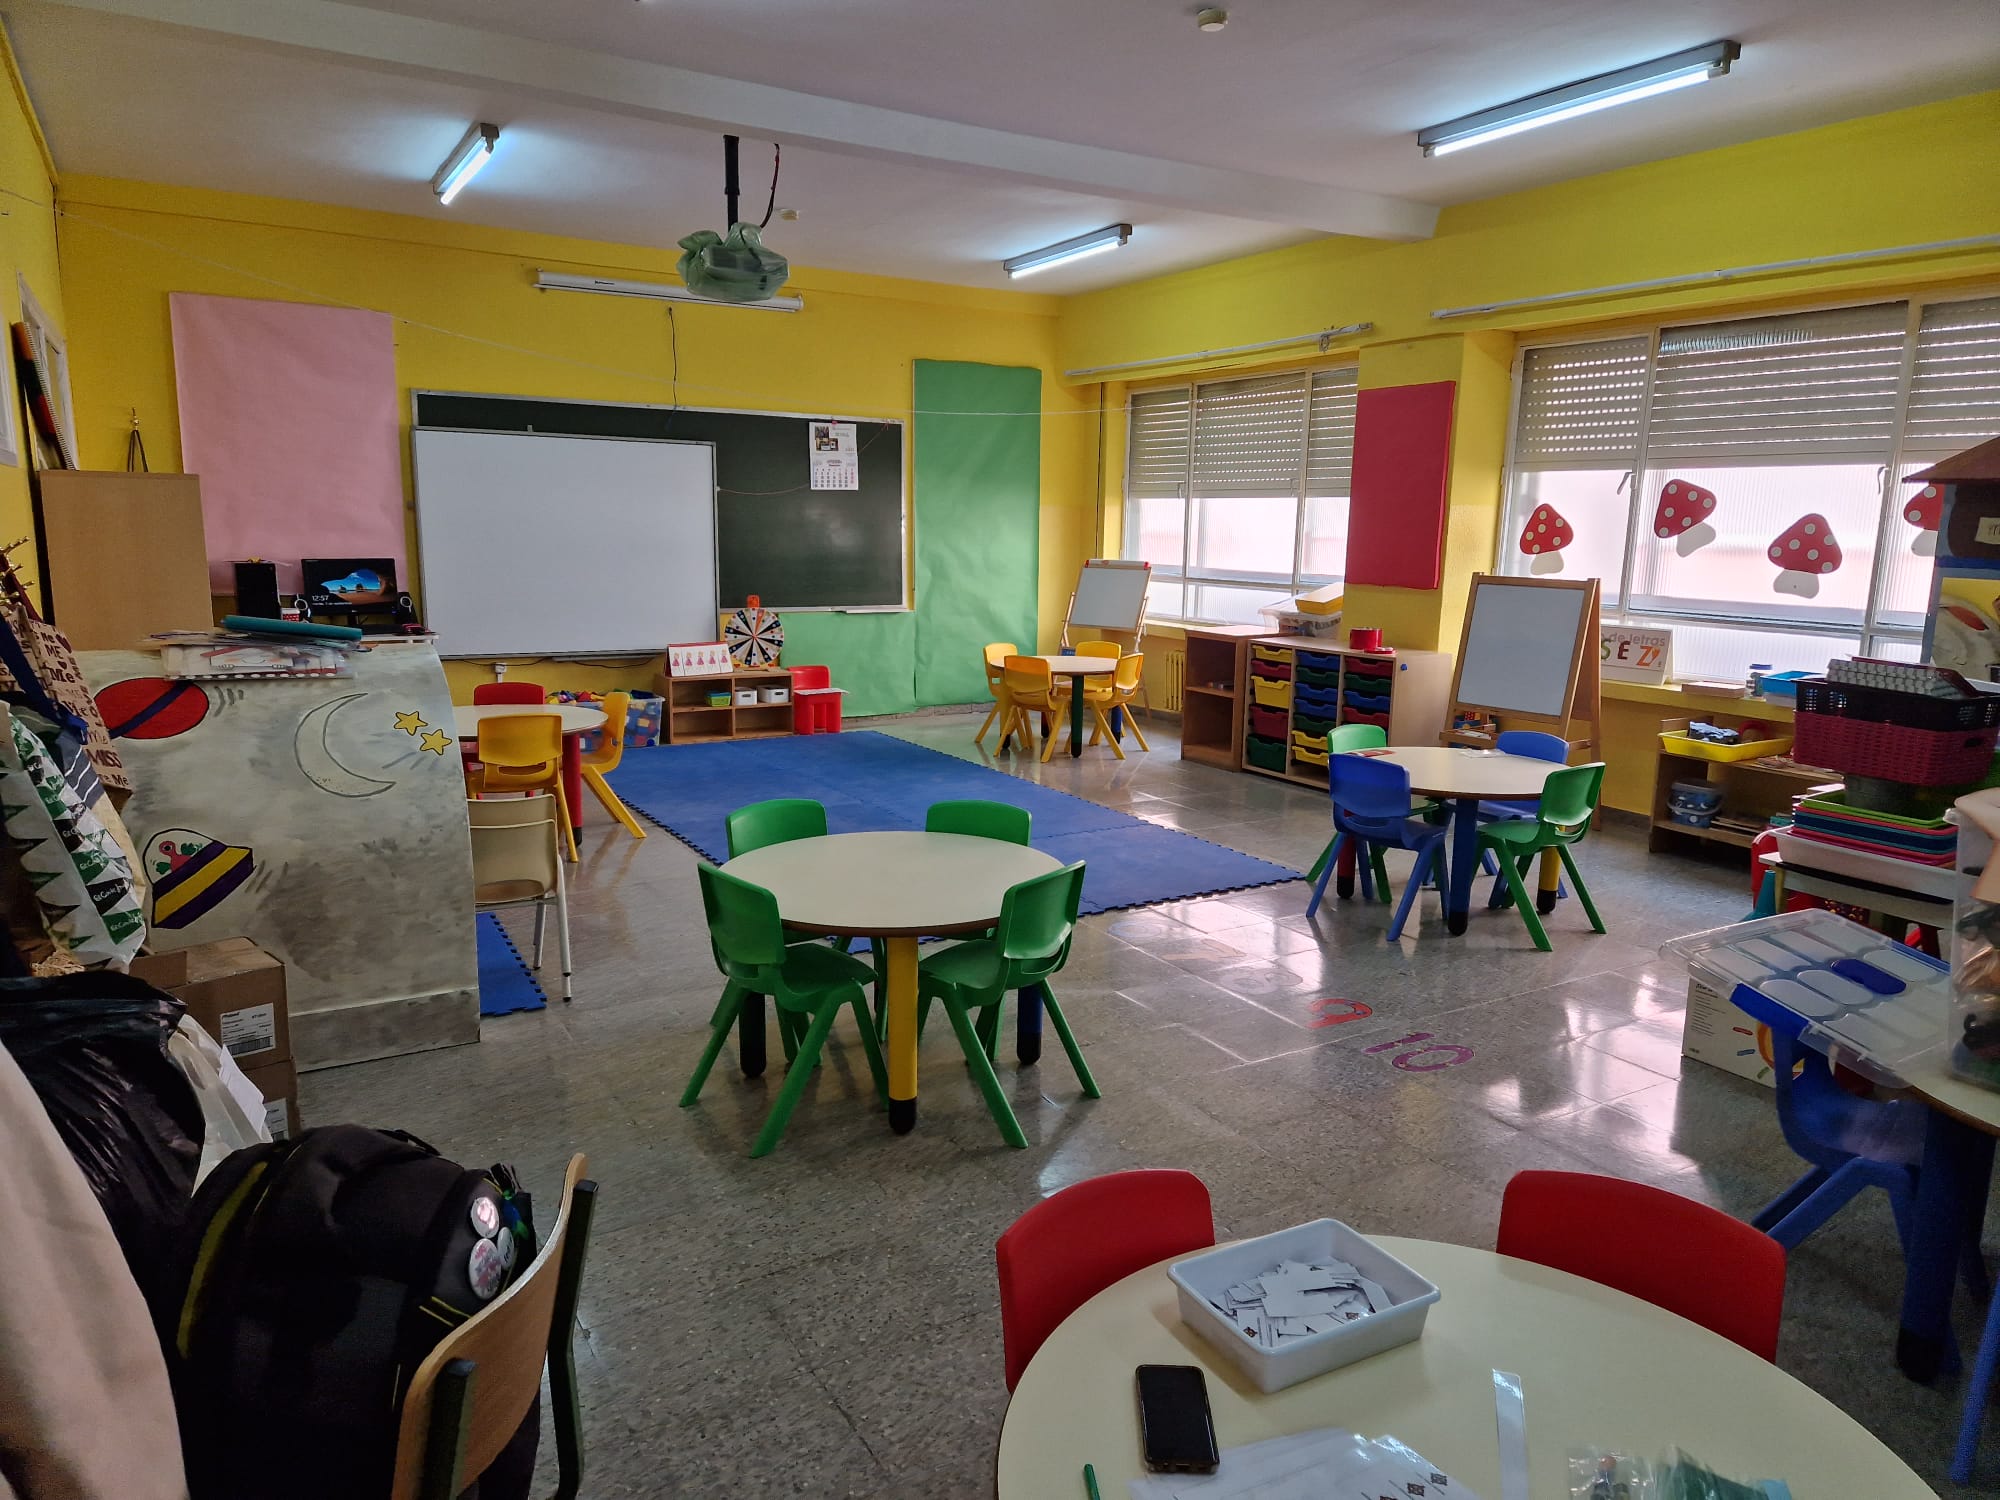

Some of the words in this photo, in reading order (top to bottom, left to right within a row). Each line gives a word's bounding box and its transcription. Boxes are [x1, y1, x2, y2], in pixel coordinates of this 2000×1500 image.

[1609, 632, 1626, 642] de
[1629, 634, 1666, 647] letras
[1617, 640, 1631, 660] E
[50, 669, 76, 683] Me
[1362, 1032, 1475, 1073] 10
